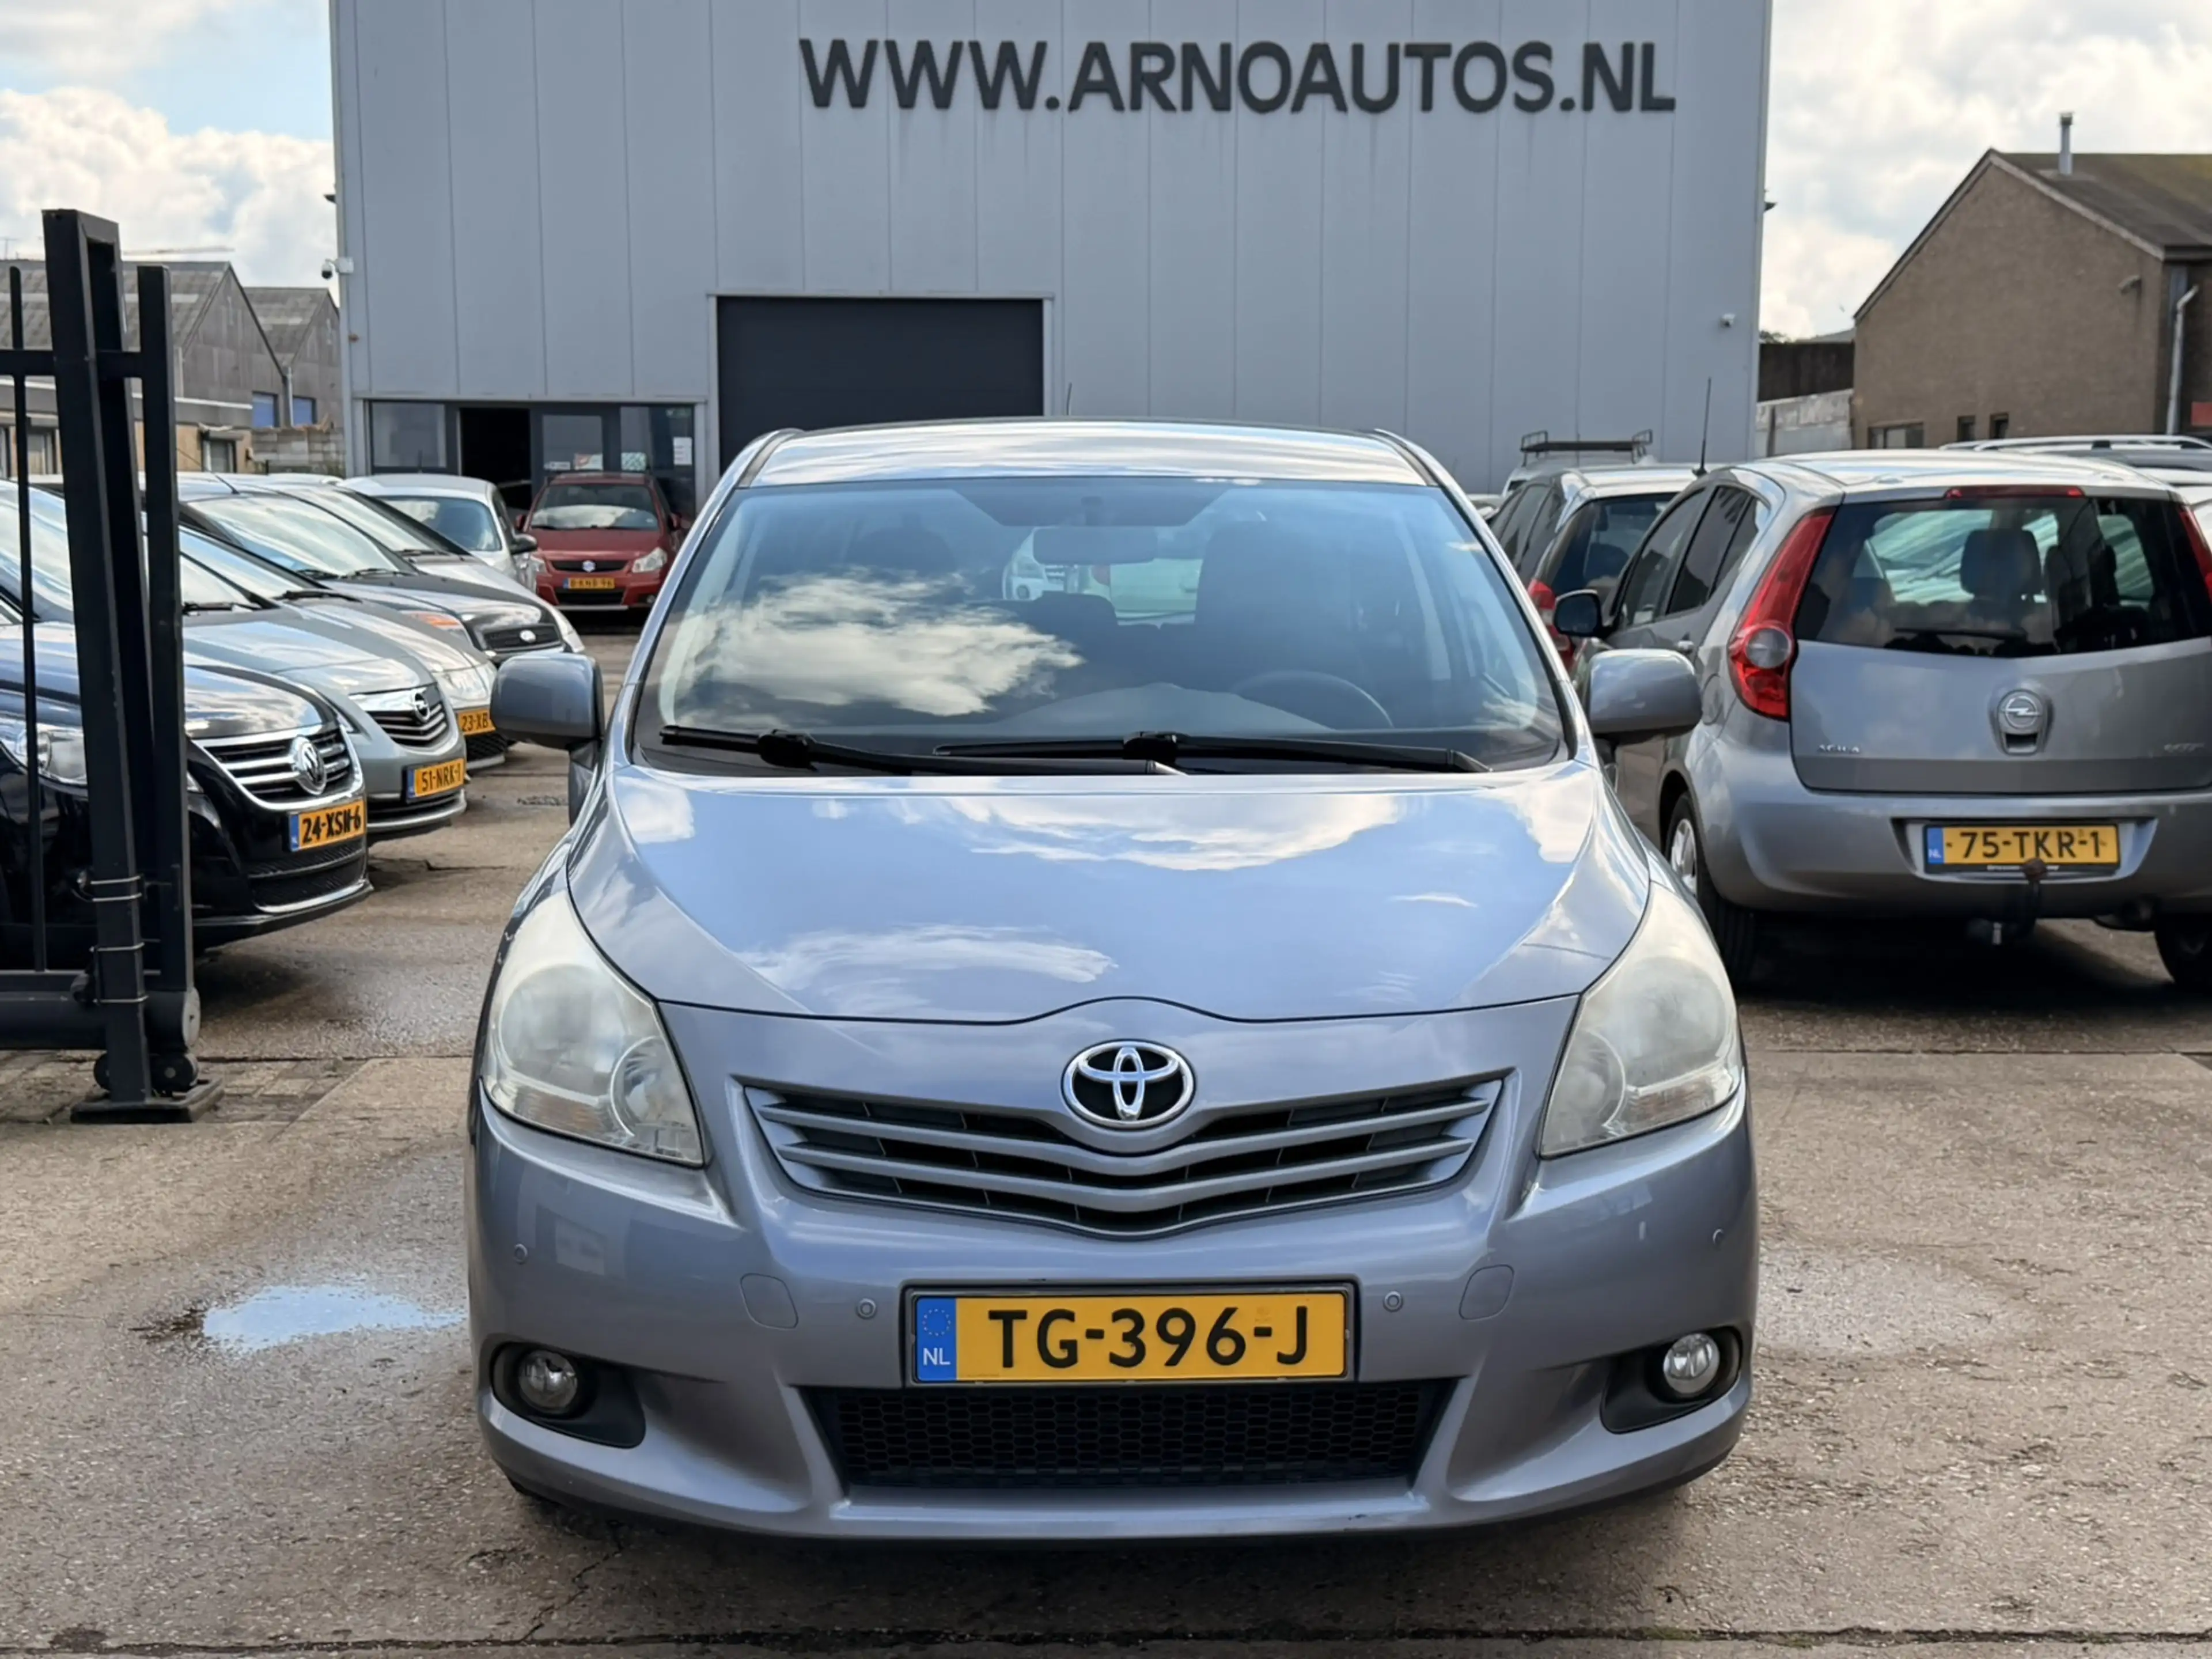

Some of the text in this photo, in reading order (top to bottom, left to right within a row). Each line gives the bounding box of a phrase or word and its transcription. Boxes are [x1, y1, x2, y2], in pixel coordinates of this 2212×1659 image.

[798, 39, 1676, 113] WWW.ARNOAUTOS.NL
[461, 712, 489, 732] 23-XB
[1960, 831, 2101, 859] 75-TKR-1
[988, 1305, 1308, 1369] TG-396-J
[922, 1347, 950, 1366] NL
